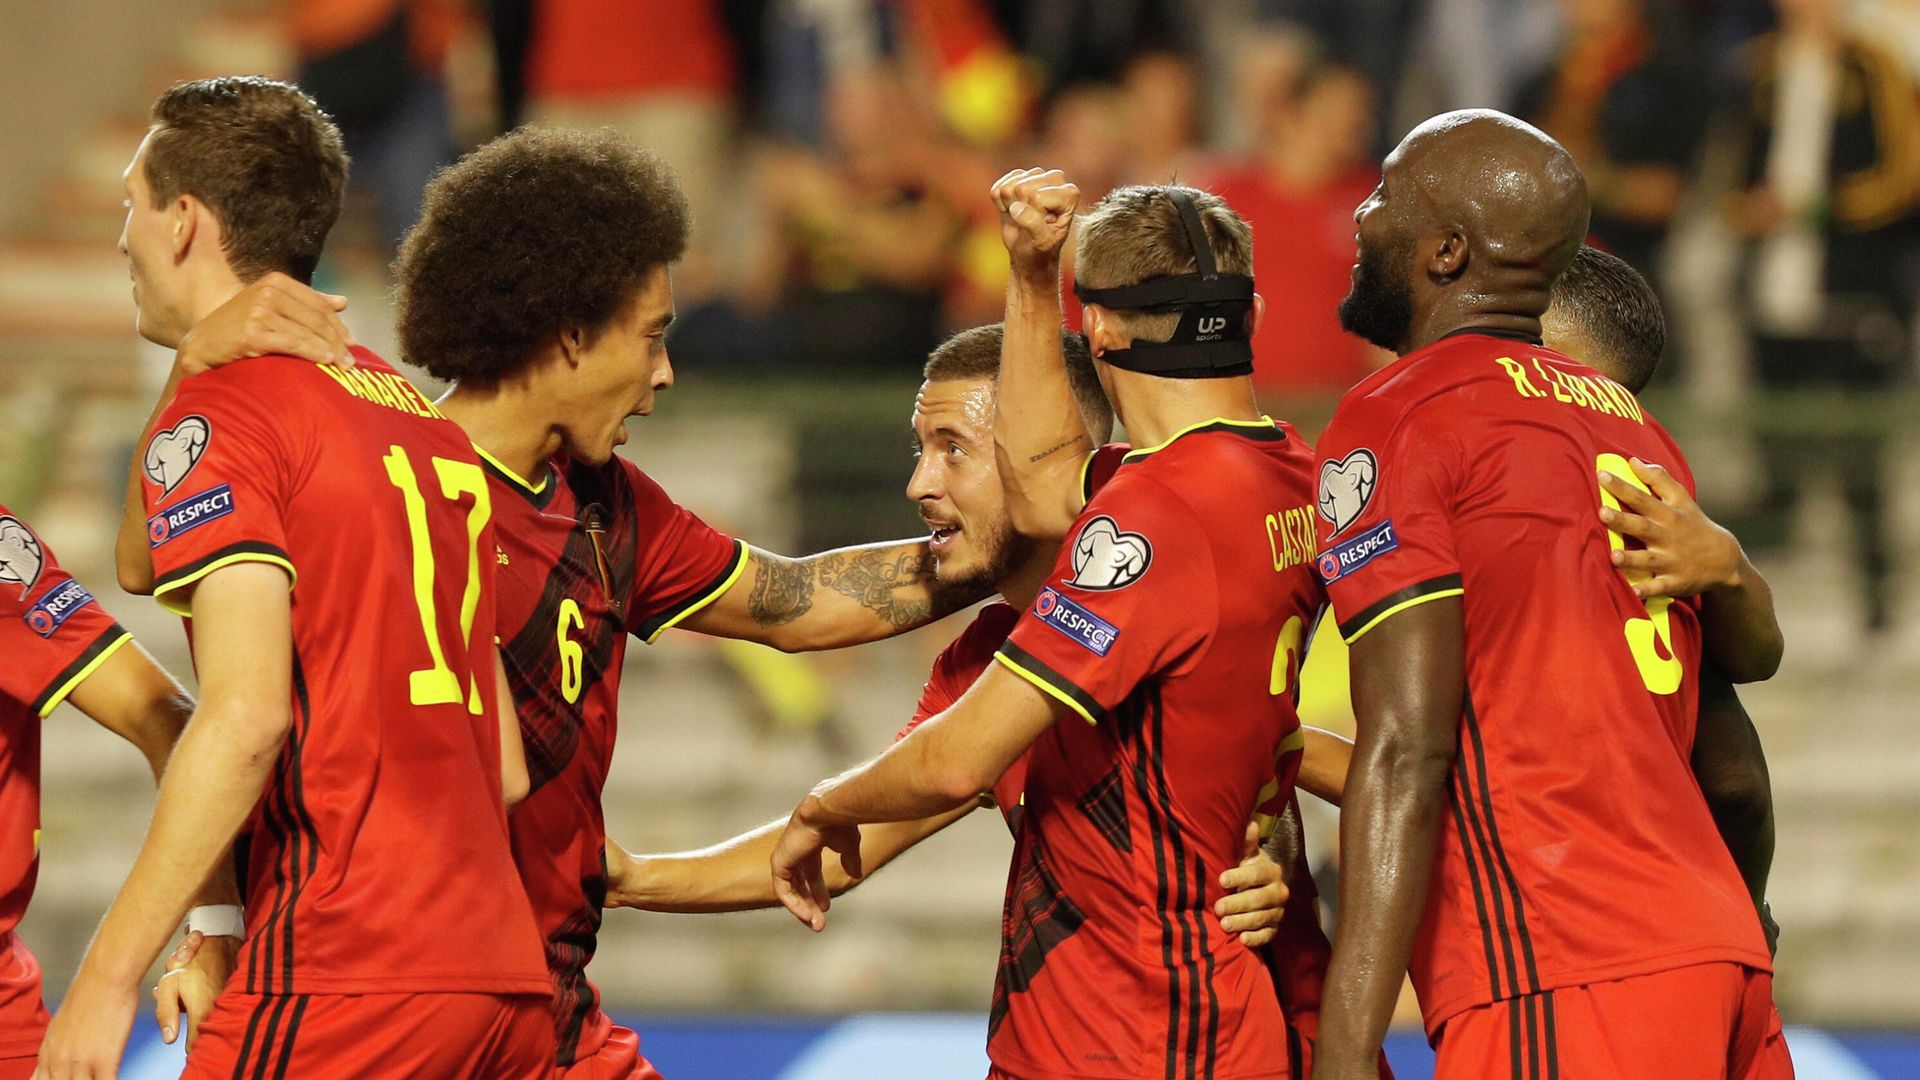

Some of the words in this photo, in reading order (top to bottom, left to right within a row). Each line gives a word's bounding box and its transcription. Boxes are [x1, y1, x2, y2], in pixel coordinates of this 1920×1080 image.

[1495, 356, 1548, 398] R.
[1531, 356, 1645, 426] LUKAKU
[168, 491, 231, 530] RESPECT
[1338, 526, 1392, 567] RESPECT
[383, 444, 492, 715] 17
[556, 598, 584, 704] 6
[1052, 604, 1116, 649] RESPECT
